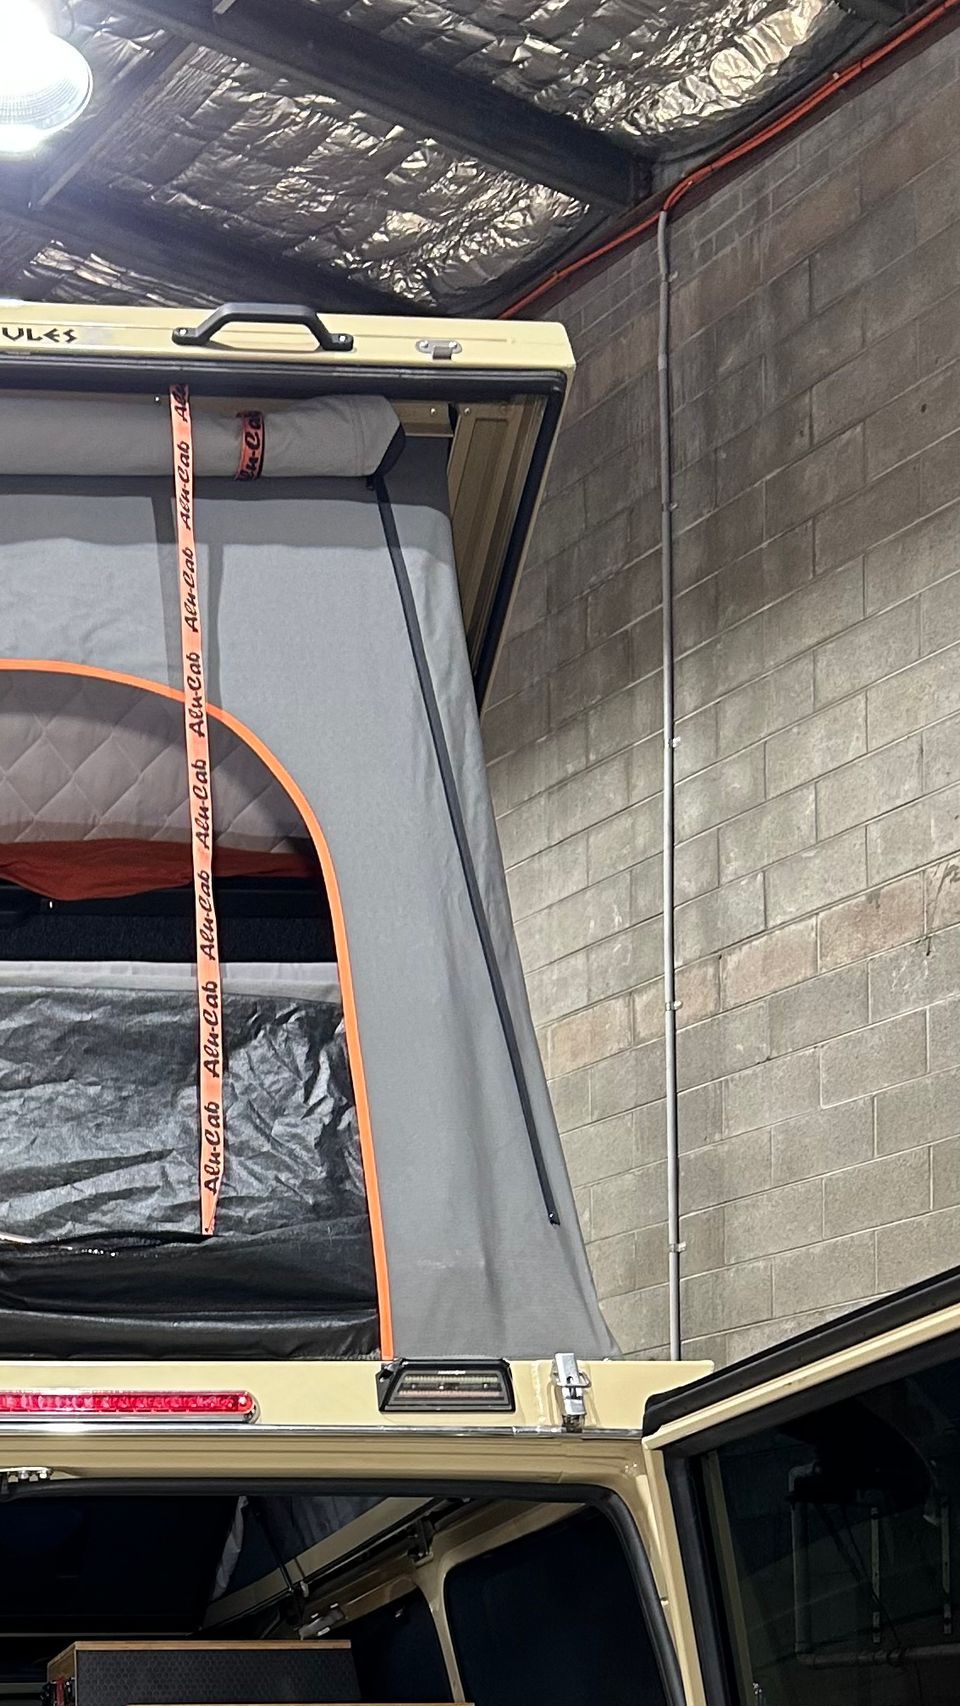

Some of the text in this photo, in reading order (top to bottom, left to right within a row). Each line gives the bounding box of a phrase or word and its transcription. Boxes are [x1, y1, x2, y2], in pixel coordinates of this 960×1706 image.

[177, 440, 221, 1196] Alu-Cab Alu-Cab Alu-Cab Alu-Cab Alu-Cab Alu-Cab Alu-Cab
